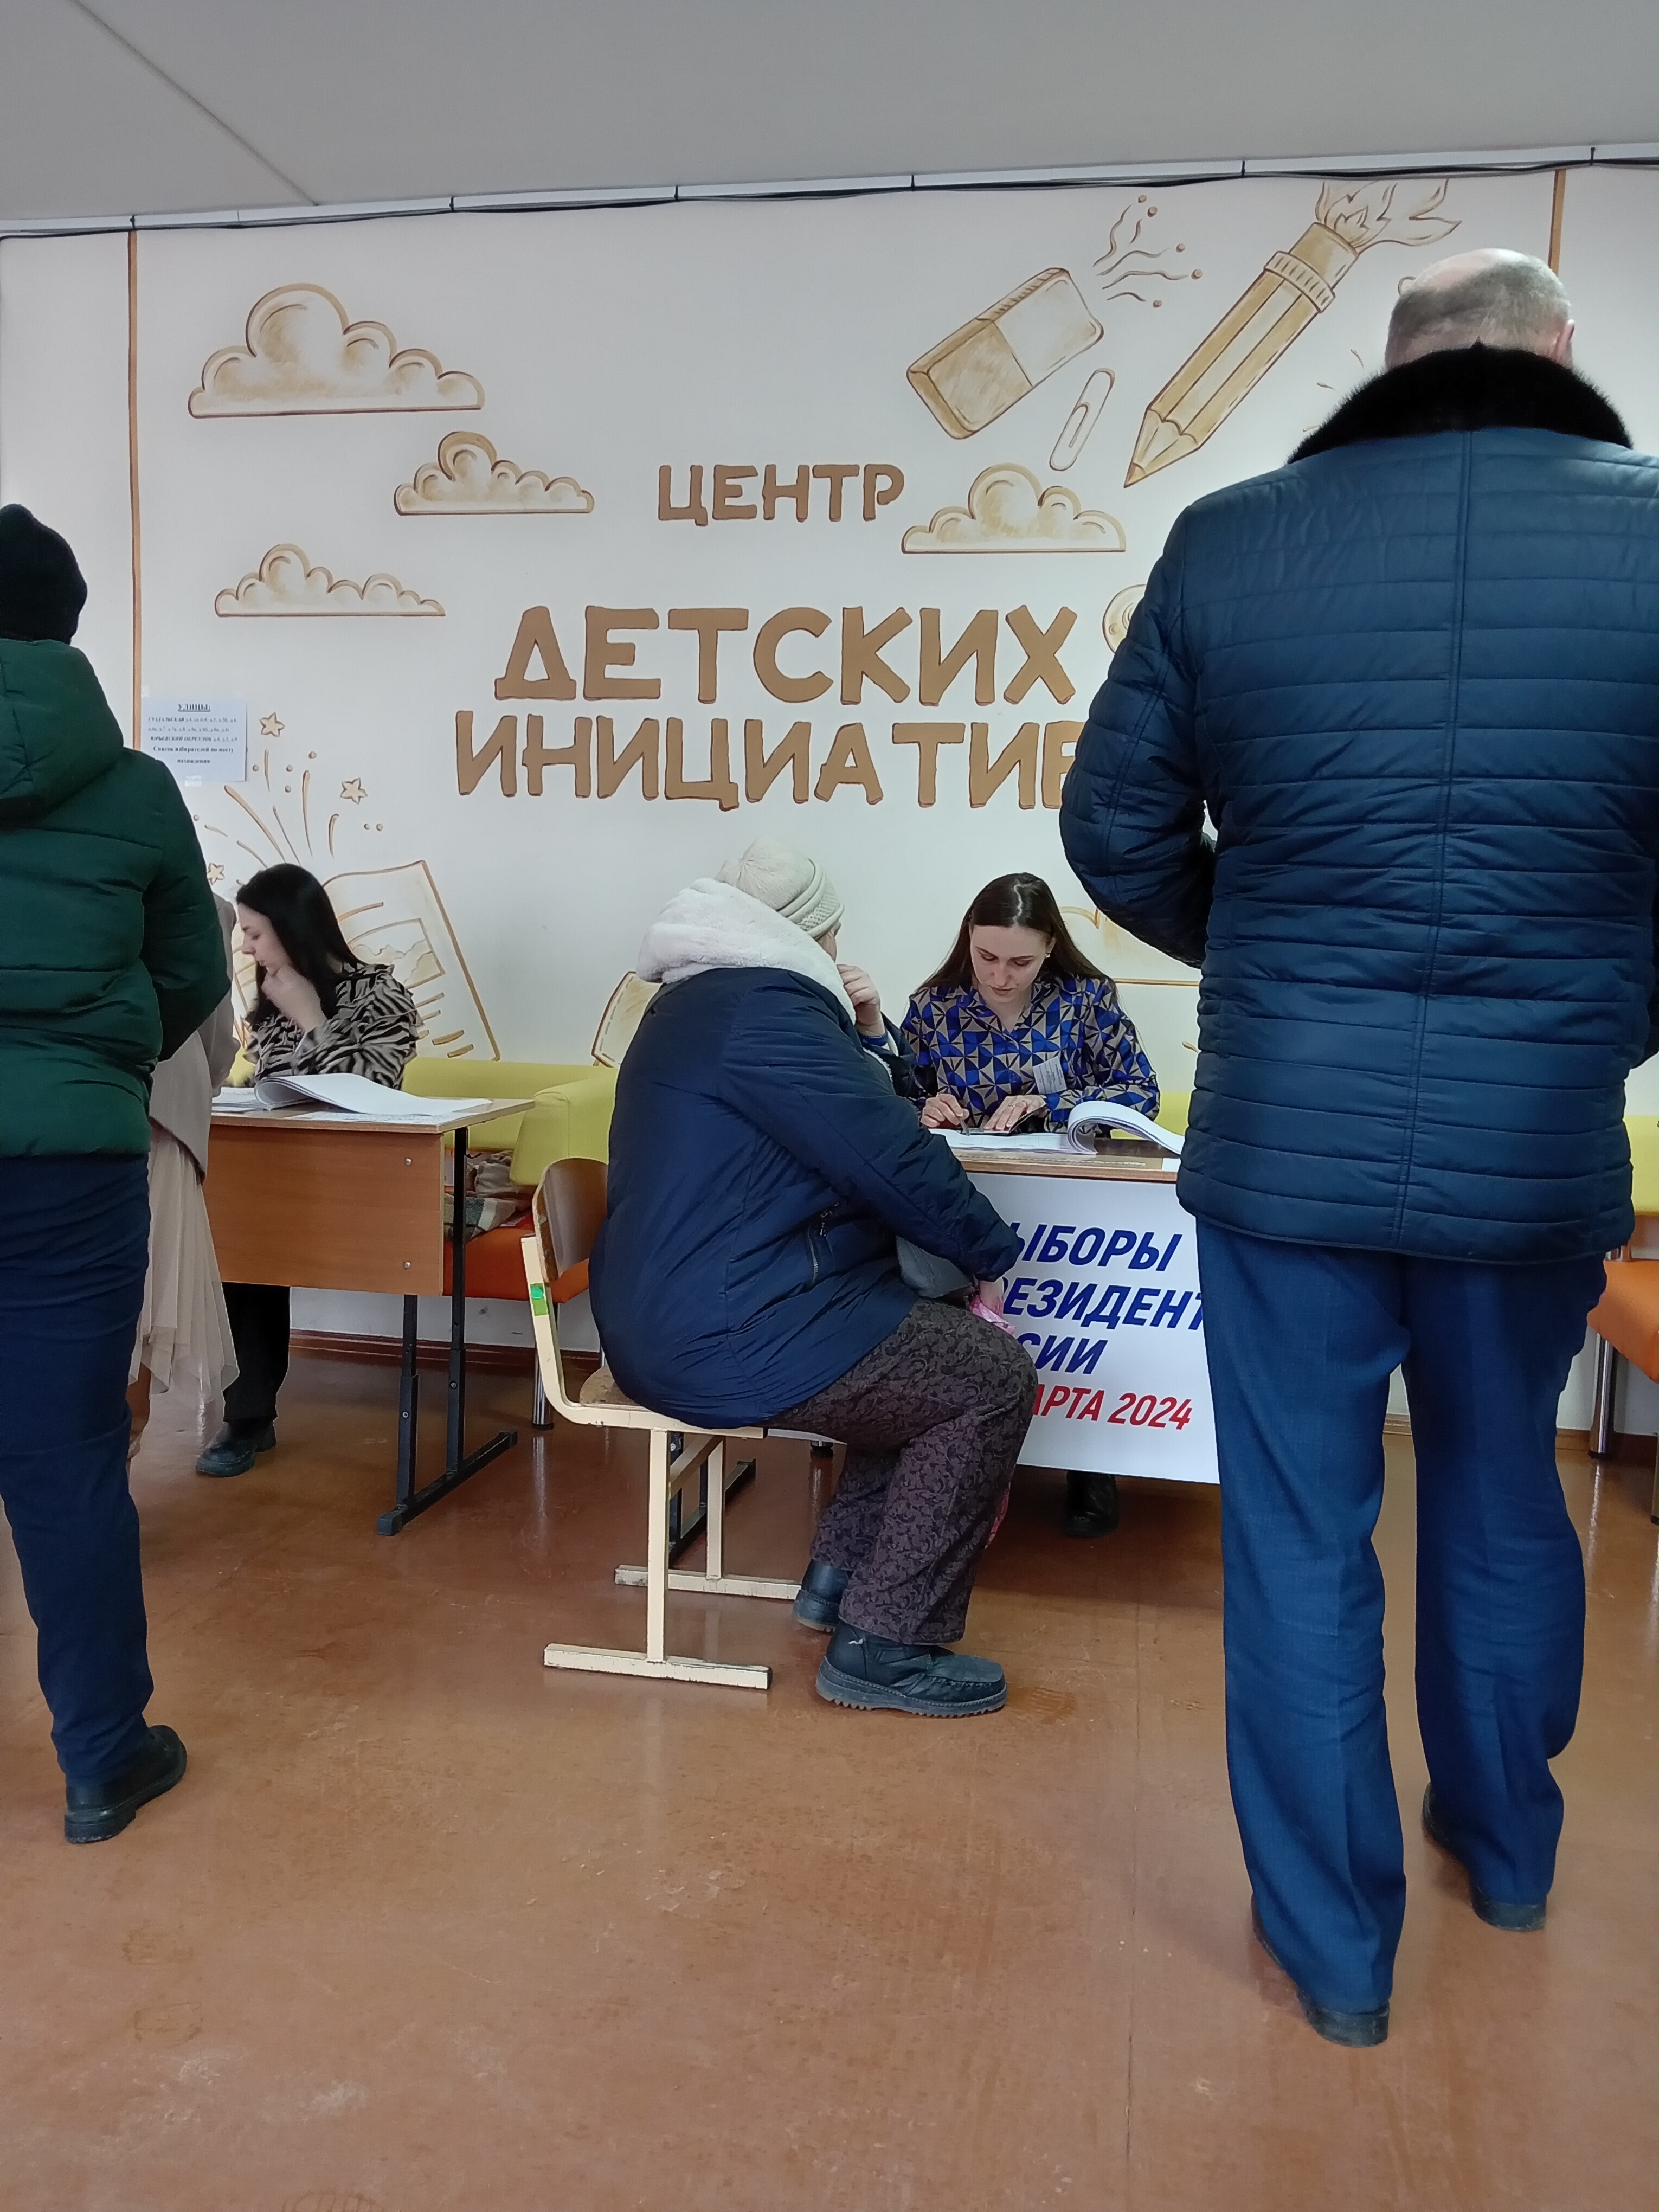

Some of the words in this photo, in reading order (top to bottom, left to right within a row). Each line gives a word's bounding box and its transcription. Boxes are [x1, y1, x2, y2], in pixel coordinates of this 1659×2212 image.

[658, 464, 904, 526] ЦЕНТР
[494, 605, 1077, 705] ДЕТСКИХ
[1010, 1221, 1182, 1272] ЫБОРЫ
[1107, 1392, 1193, 1430] 2024
